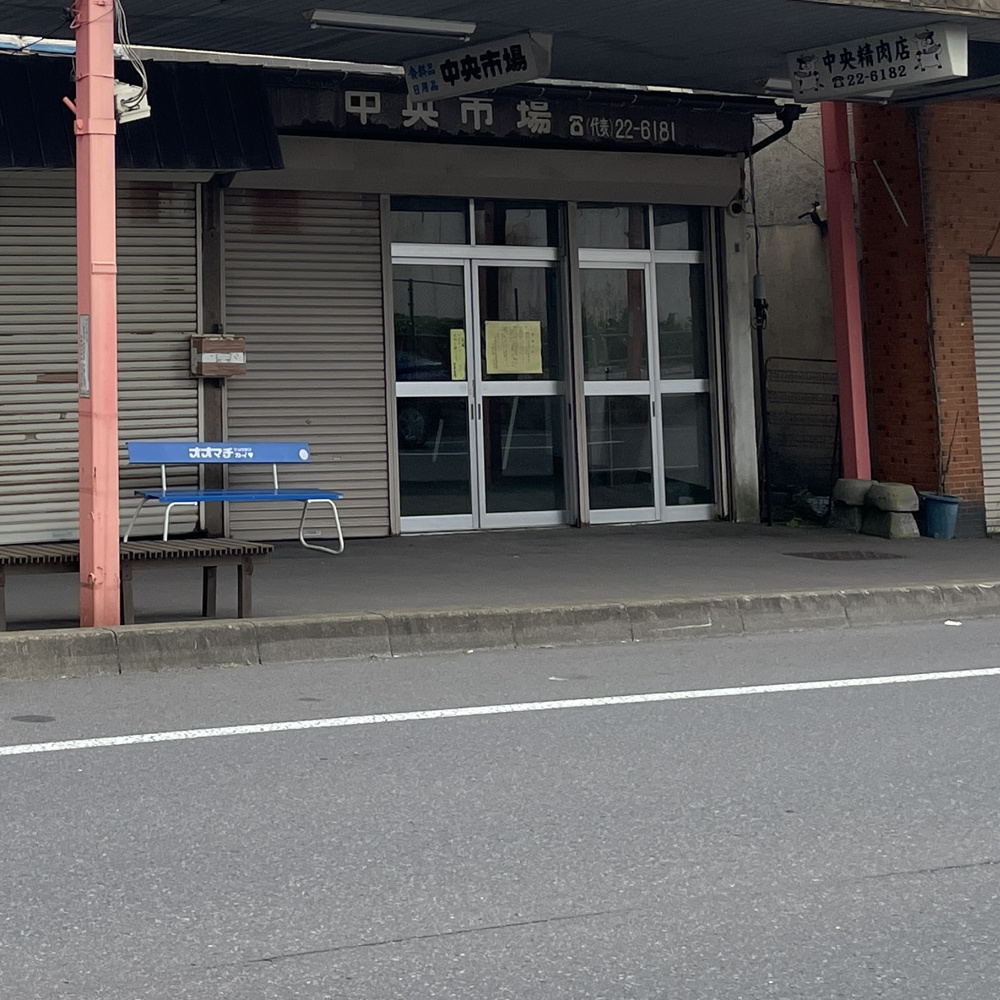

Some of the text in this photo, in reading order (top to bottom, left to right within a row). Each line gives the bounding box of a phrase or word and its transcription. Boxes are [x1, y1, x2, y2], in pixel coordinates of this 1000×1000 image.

[439, 44, 528, 86] 中央市場
[822, 36, 911, 74] 中央精肉店
[413, 80, 439, 96] 日用品
[847, 64, 907, 87] 22-6182
